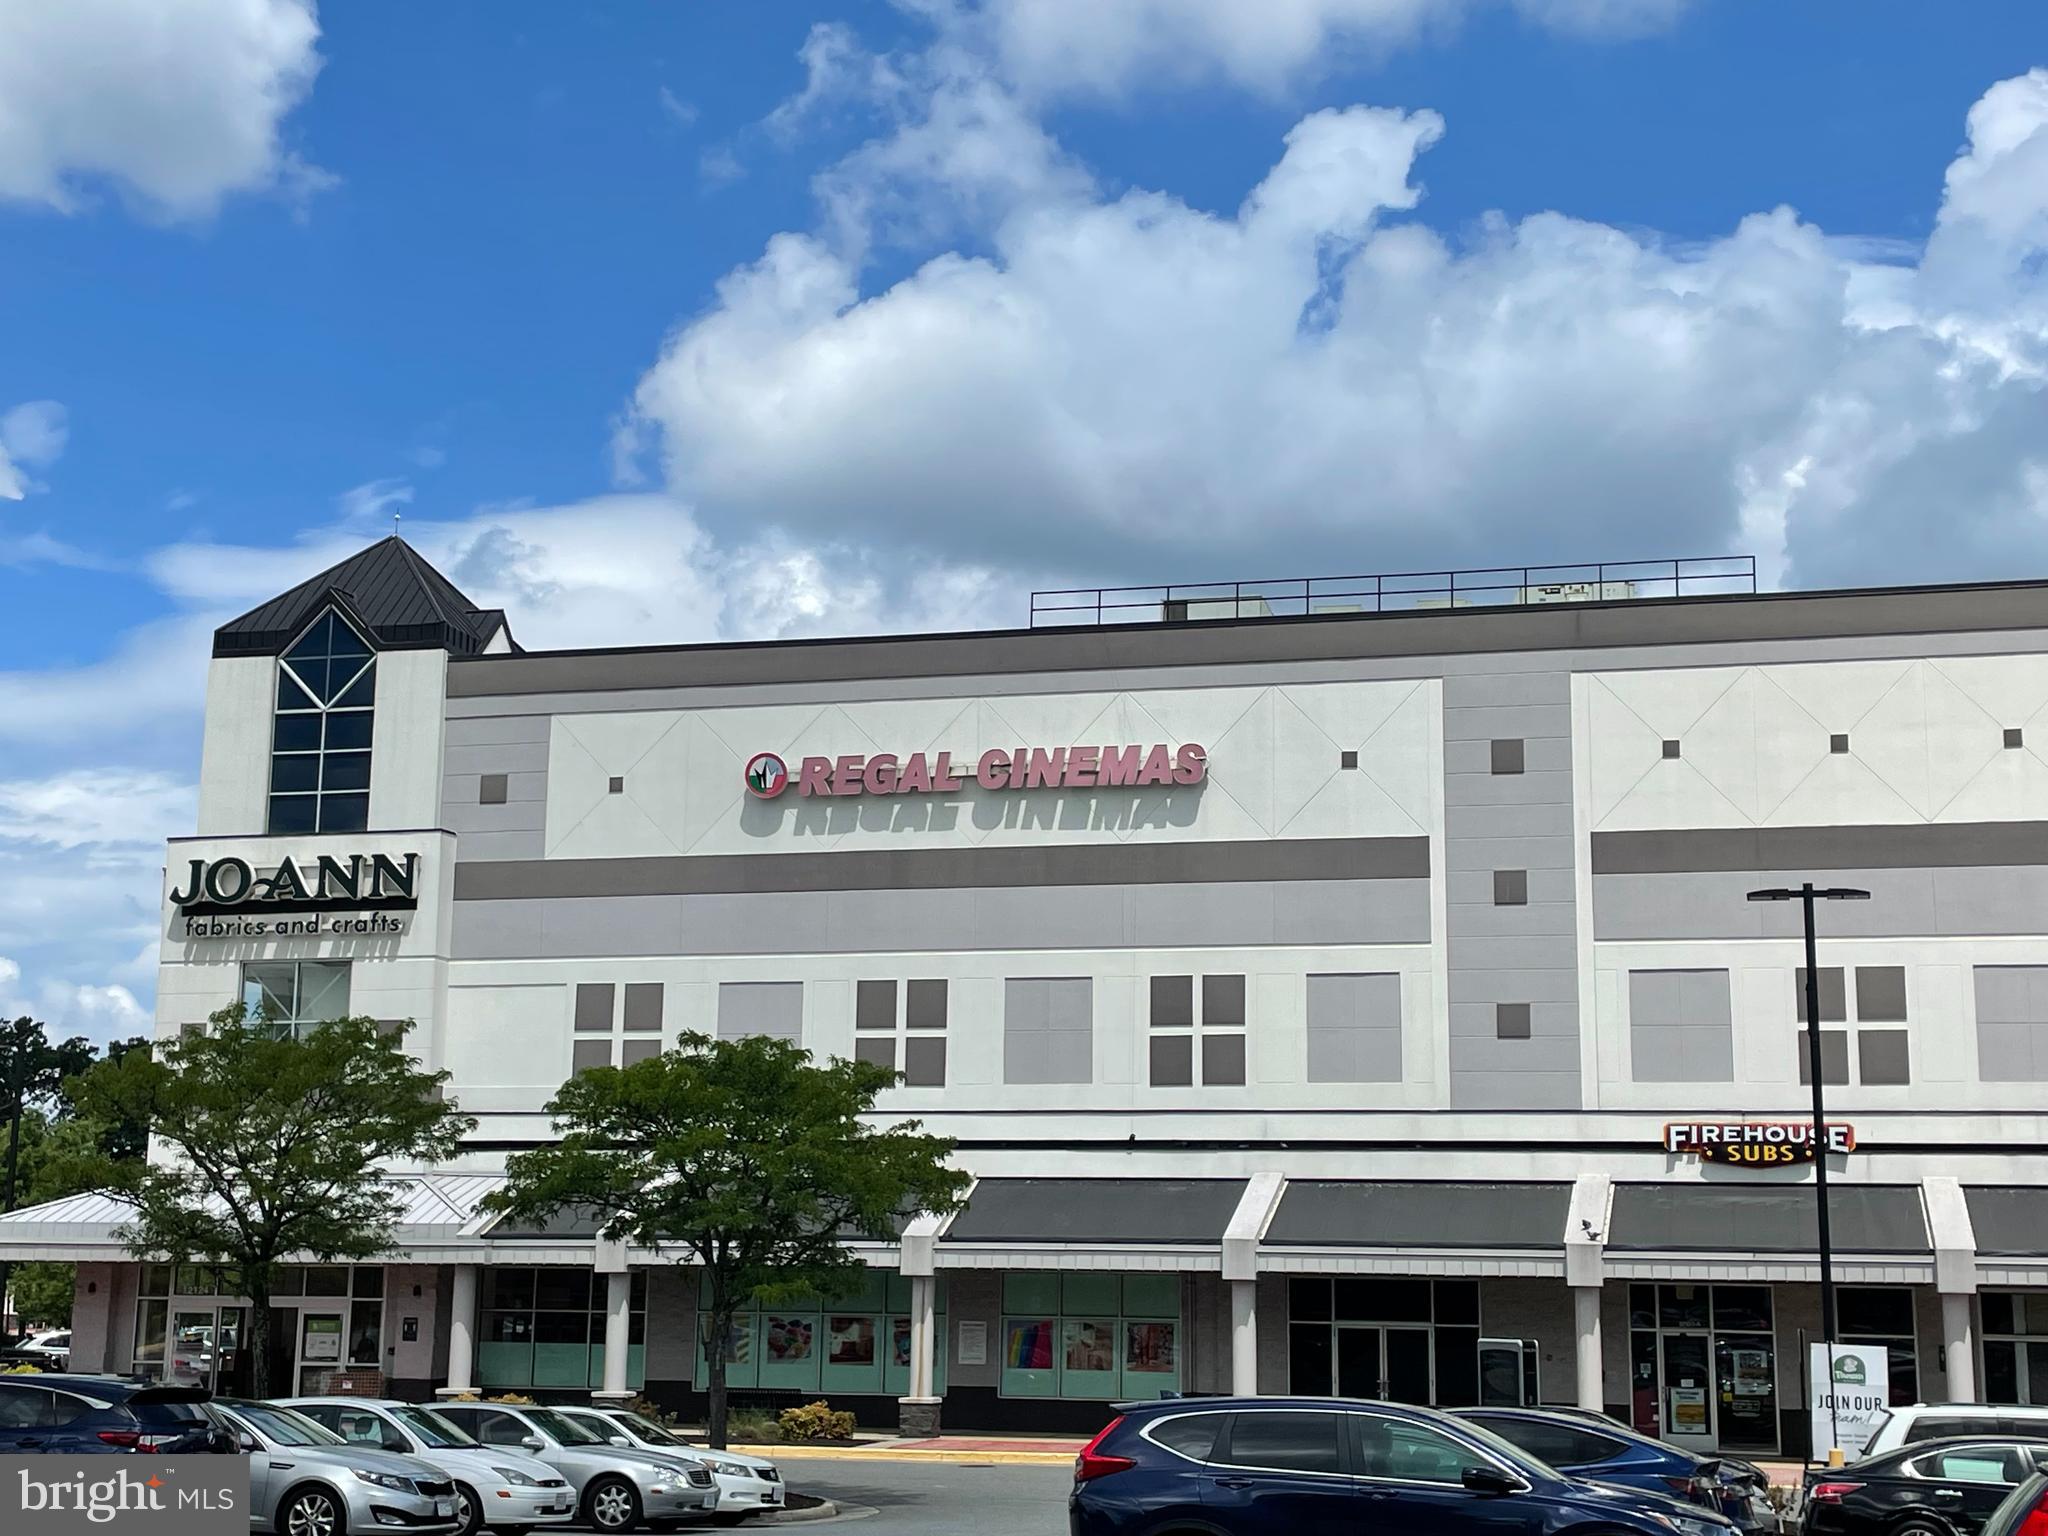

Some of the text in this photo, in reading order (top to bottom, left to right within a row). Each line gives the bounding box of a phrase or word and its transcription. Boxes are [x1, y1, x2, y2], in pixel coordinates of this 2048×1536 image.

[802, 743, 1208, 796] REGAL CINEMAS
[185, 911, 401, 937] fabrics and crafts
[1727, 1145, 1795, 1162] SUBS
[1818, 1394, 1882, 1411] JOIN OUR
